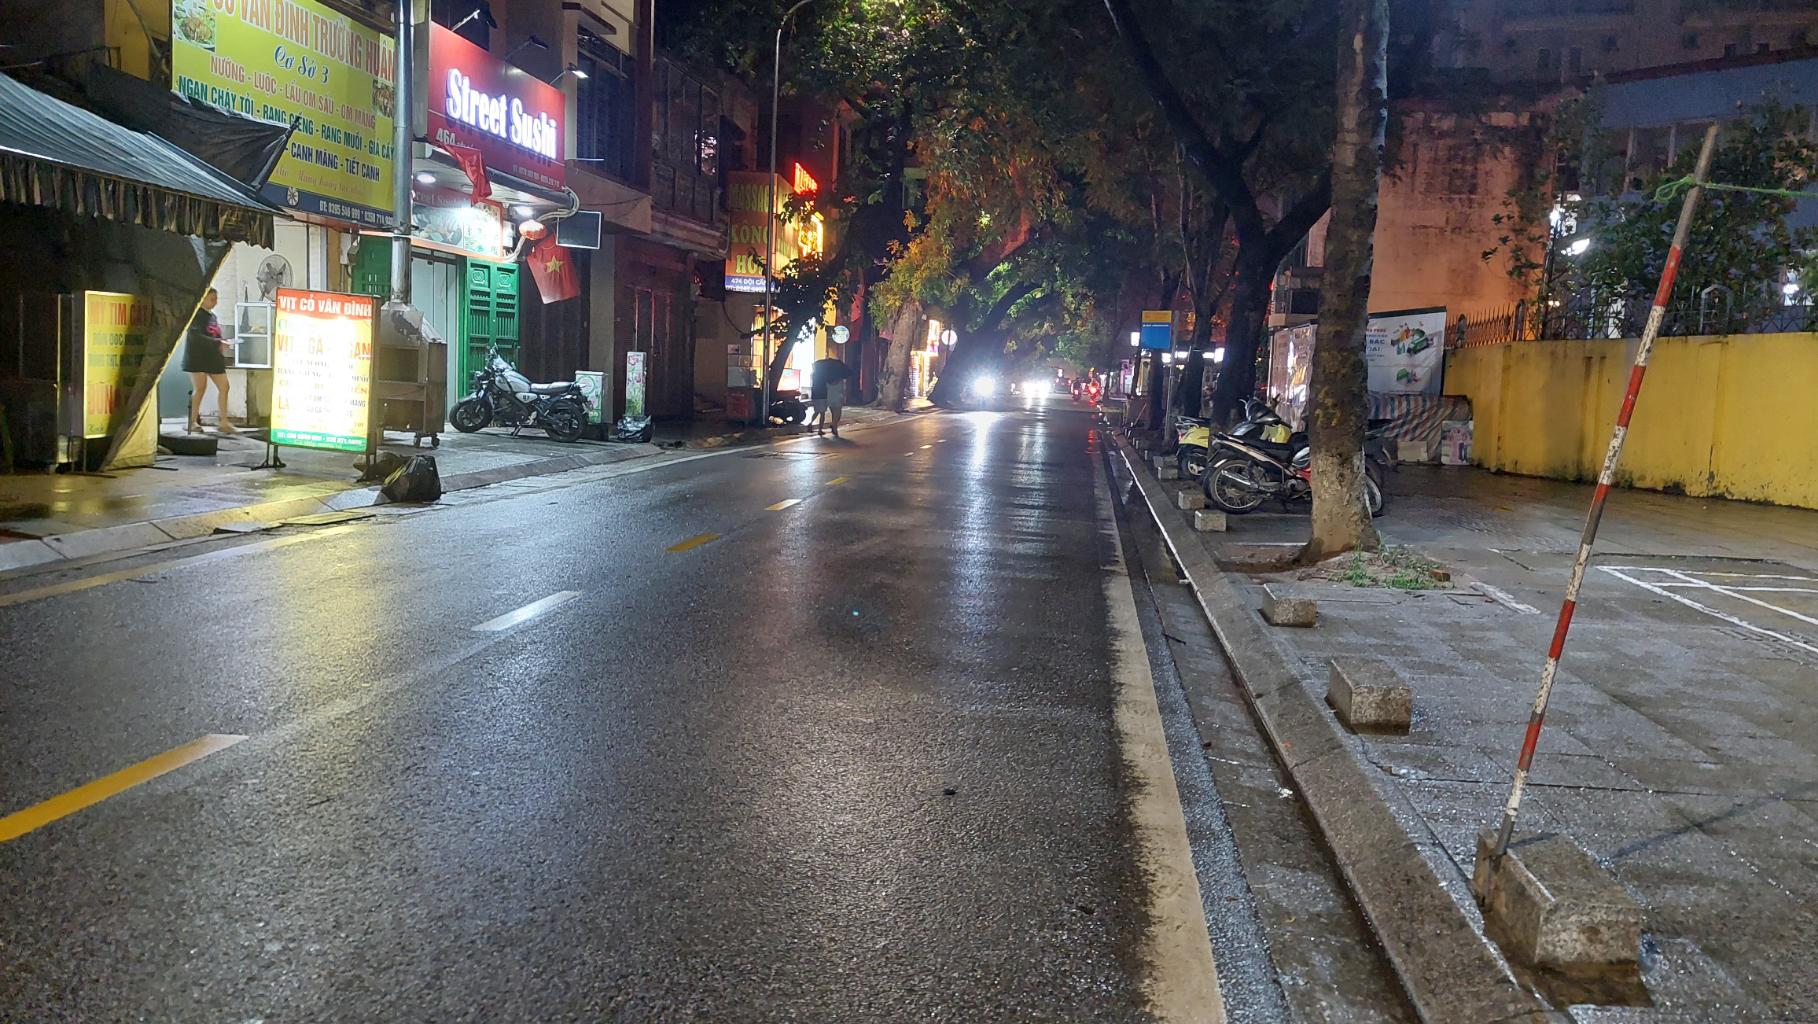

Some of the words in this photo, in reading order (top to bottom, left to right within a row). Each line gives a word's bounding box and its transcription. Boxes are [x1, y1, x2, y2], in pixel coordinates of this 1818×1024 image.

[321, 66, 329, 84] 3
[178, 75, 208, 102] NGAN
[303, 91, 316, 108] OM
[446, 67, 507, 139] Street
[509, 97, 557, 160] Sushi
[291, 143, 313, 163] CANH
[362, 162, 380, 182] CANH
[279, 296, 297, 312] VỊT
[300, 294, 315, 312] CỎ
[318, 298, 341, 315] VÂN
[344, 300, 372, 318] ĐÌNH
